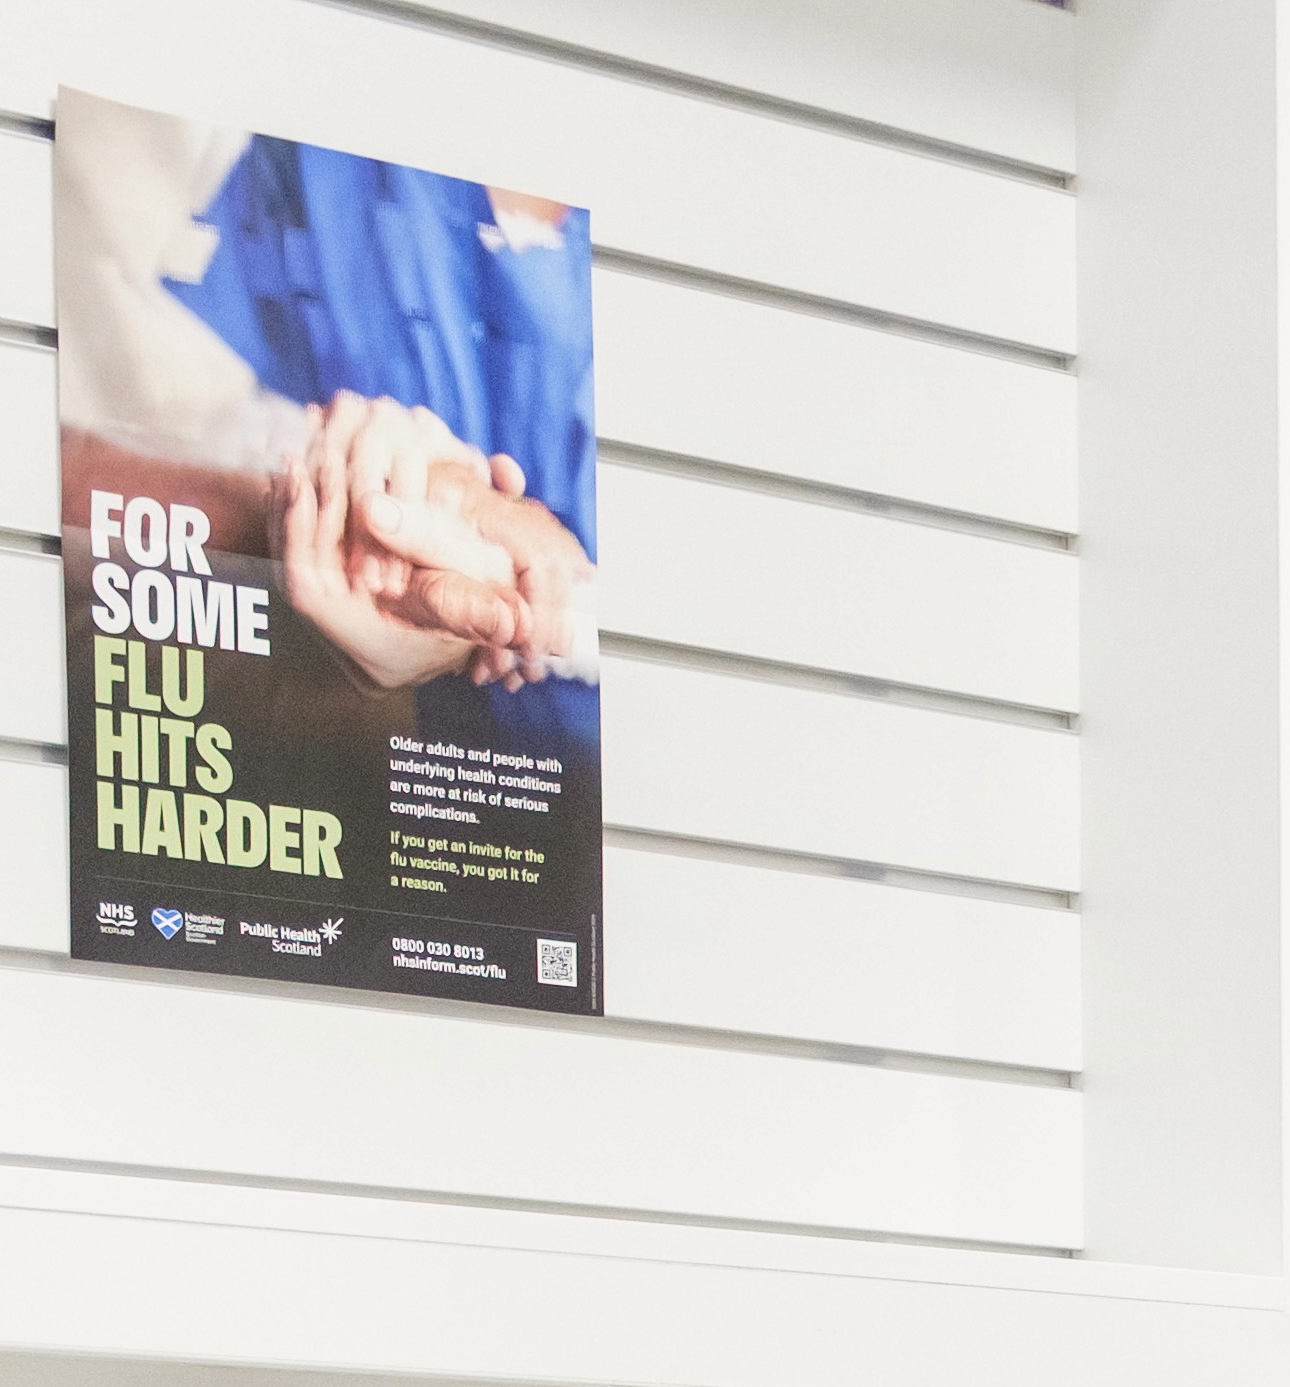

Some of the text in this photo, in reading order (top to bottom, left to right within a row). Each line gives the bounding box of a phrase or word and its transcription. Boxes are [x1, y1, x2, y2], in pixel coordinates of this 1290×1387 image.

[90, 489, 212, 576] FOR
[91, 562, 271, 657] SOME
[93, 635, 204, 718] FLU
[95, 709, 233, 794] HITS
[390, 736, 562, 773] Older adults and people with
[390, 758, 561, 794] underlying health conditions
[390, 781, 549, 812] are more at risk of serious
[390, 801, 480, 824] complications.
[96, 781, 344, 879] HARDER
[390, 831, 545, 863] If you get an invite for the
[390, 851, 539, 884] flu vaccine, you got it for
[390, 874, 447, 893] a reason.
[99, 902, 134, 920] NHS
[185, 922, 225, 935] Scotland
[239, 921, 278, 939] Public
[280, 925, 321, 944] Health
[271, 939, 321, 957] Scotland
[392, 937, 485, 961] 0800 030 8013
[392, 953, 507, 979] nhsinform.scot/flu
